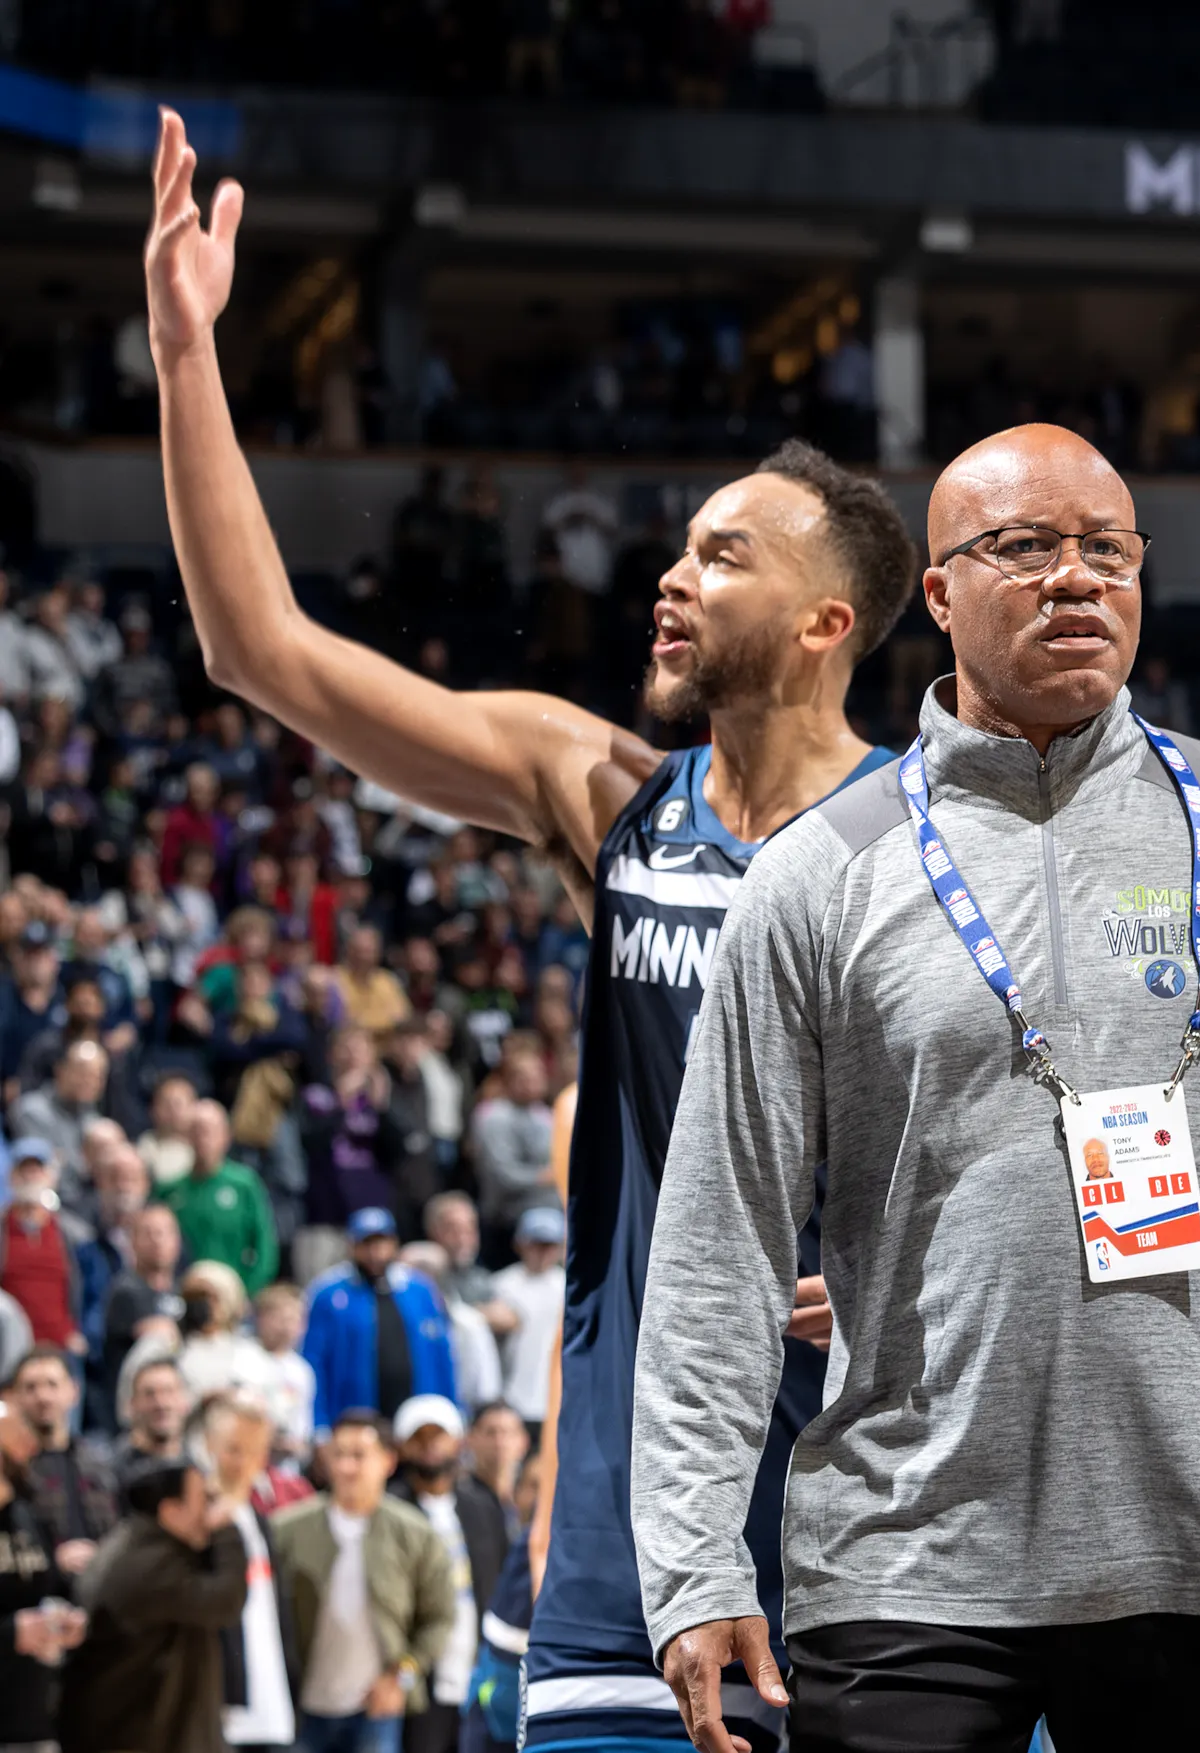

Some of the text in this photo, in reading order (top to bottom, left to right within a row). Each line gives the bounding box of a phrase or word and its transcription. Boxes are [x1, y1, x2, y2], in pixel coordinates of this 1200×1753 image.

[657, 799, 686, 832] 6
[923, 848, 953, 881] NBA
[948, 897, 980, 929] NBA
[1148, 905, 1171, 918] LOS
[976, 945, 1007, 977] NBA
[1102, 1111, 1148, 1129] NBA SEASON
[1113, 1137, 1132, 1145] TONY
[1115, 1146, 1140, 1155] ADAMS
[1088, 1188, 1096, 1202] C
[1111, 1185, 1118, 1199] L
[1177, 1176, 1185, 1190] E
[1136, 1231, 1158, 1247] TEAM
